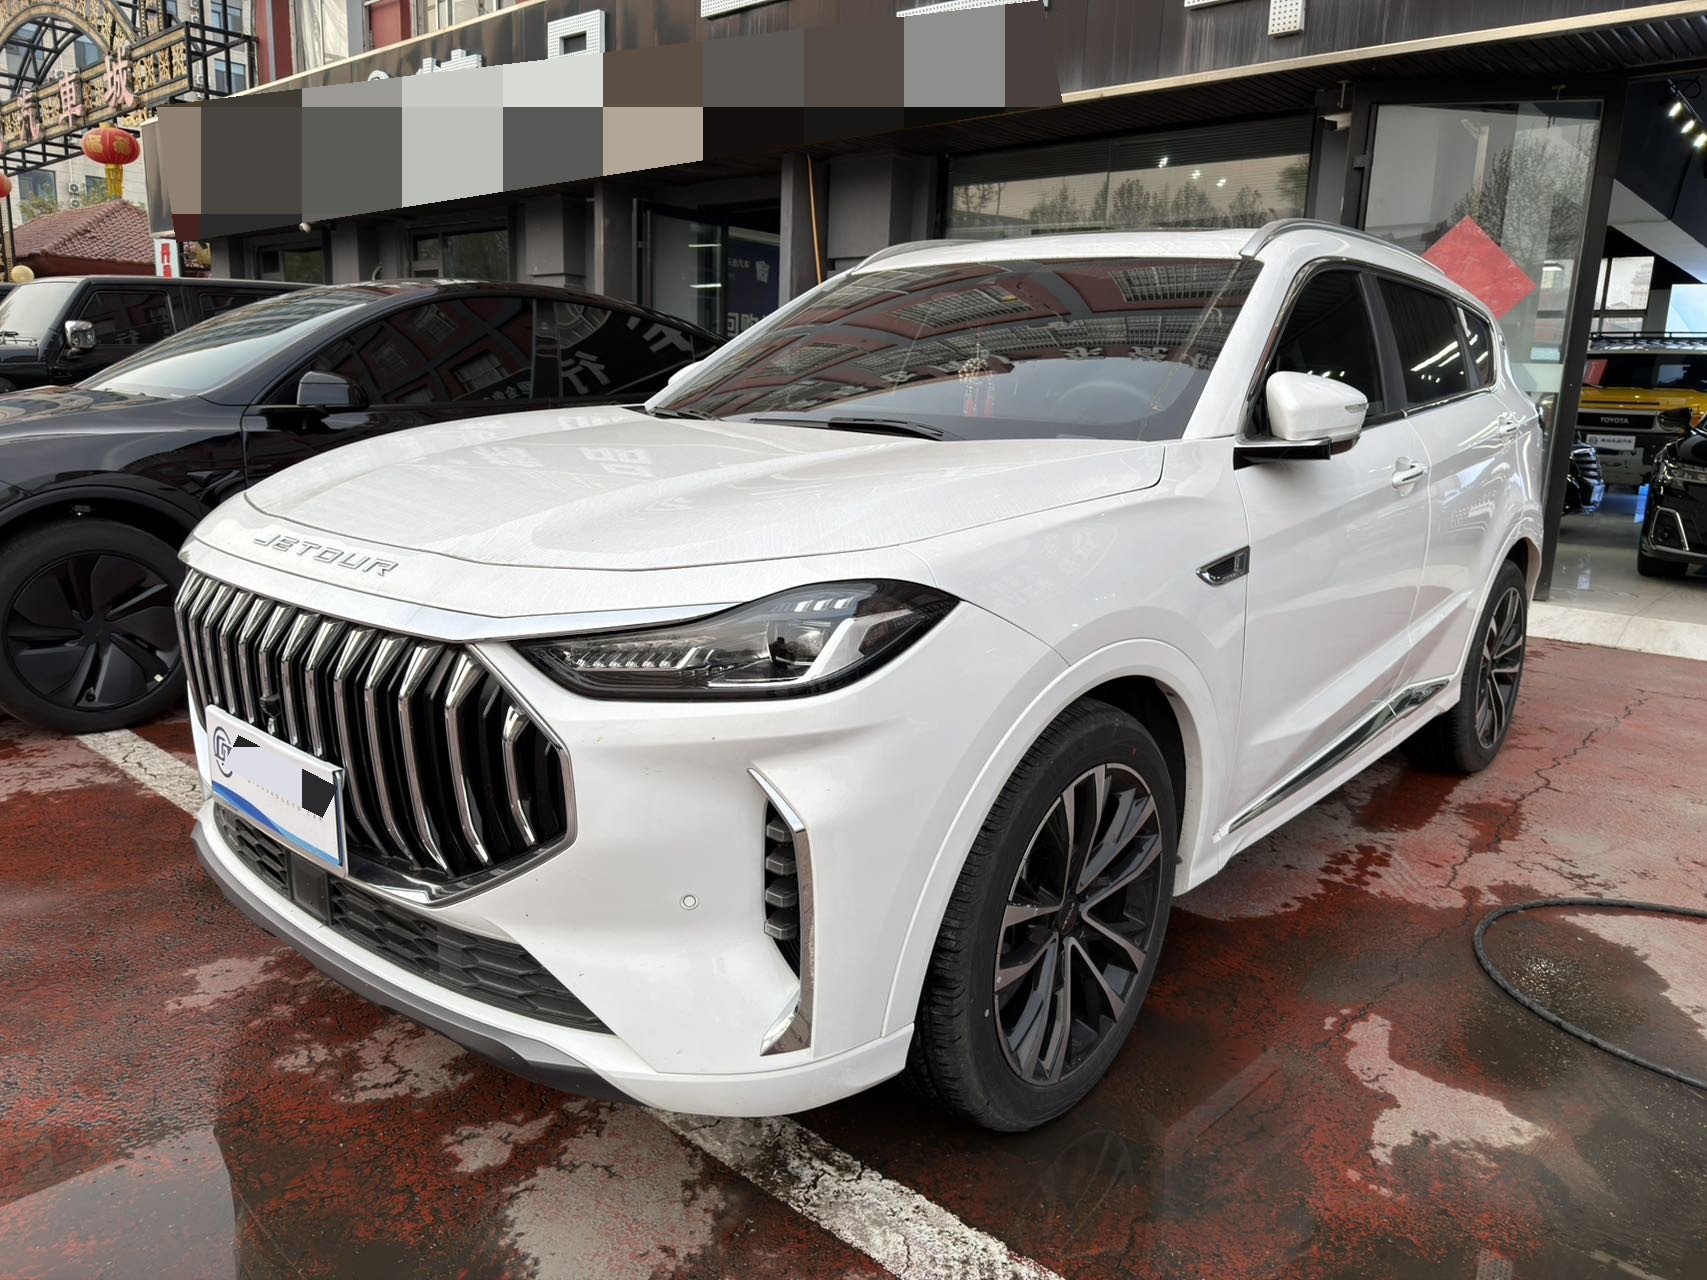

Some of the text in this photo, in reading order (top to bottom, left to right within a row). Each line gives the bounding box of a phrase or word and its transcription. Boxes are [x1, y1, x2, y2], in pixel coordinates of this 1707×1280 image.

[0, 45, 134, 156] 汽車城
[1600, 416, 1629, 424] TOYOTA
[253, 534, 399, 577] JETOUR
